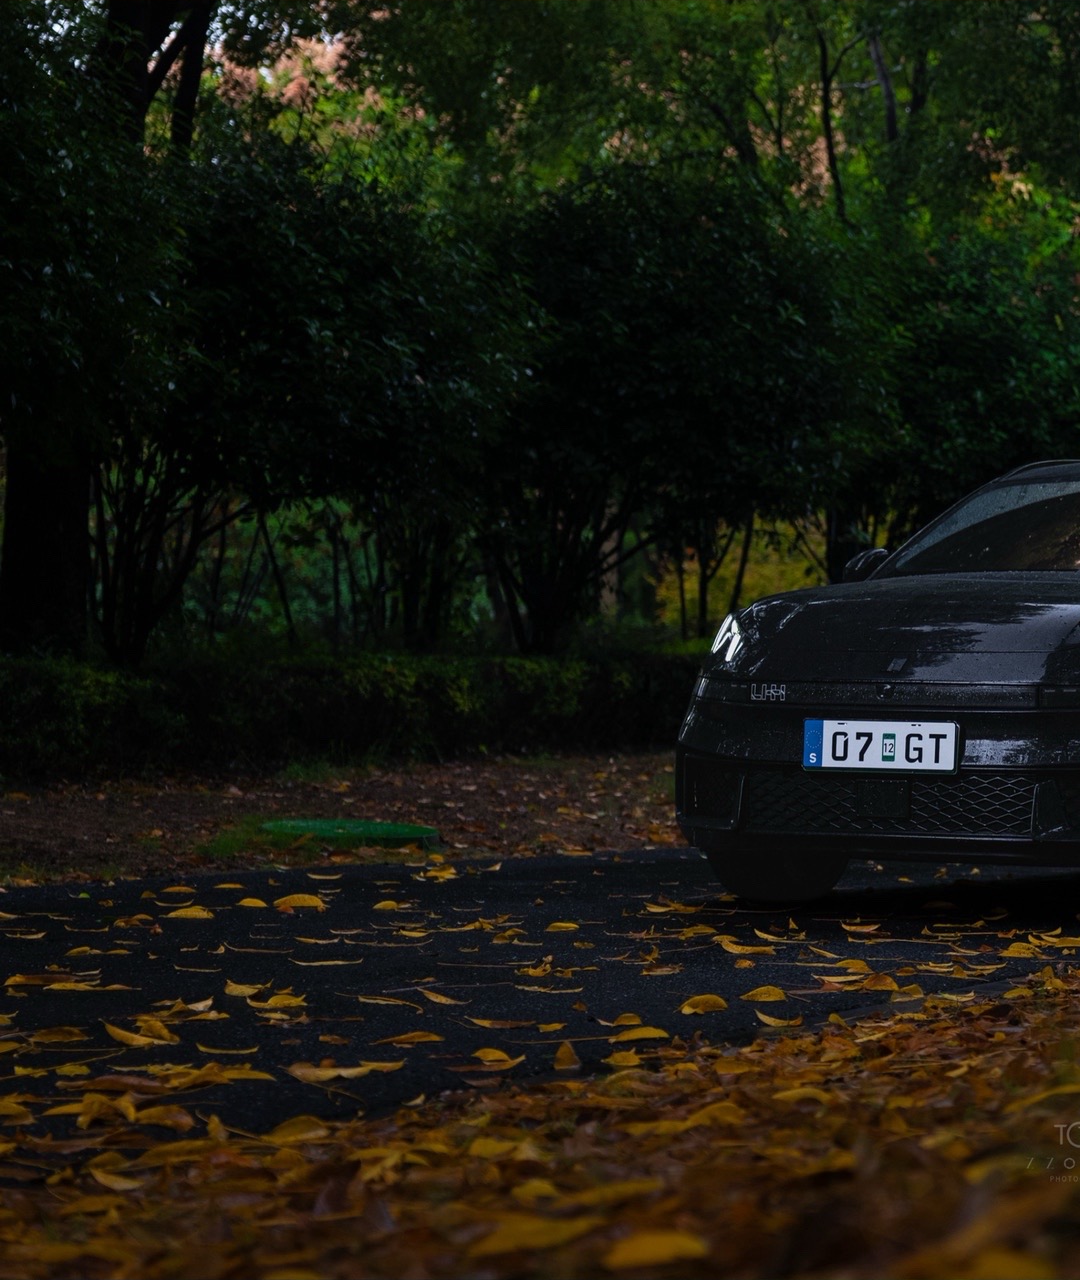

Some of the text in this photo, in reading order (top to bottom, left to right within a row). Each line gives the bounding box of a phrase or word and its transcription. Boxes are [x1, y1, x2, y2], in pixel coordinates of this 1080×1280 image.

[831, 731, 947, 763] 07 12 GT
[809, 753, 817, 763] S
